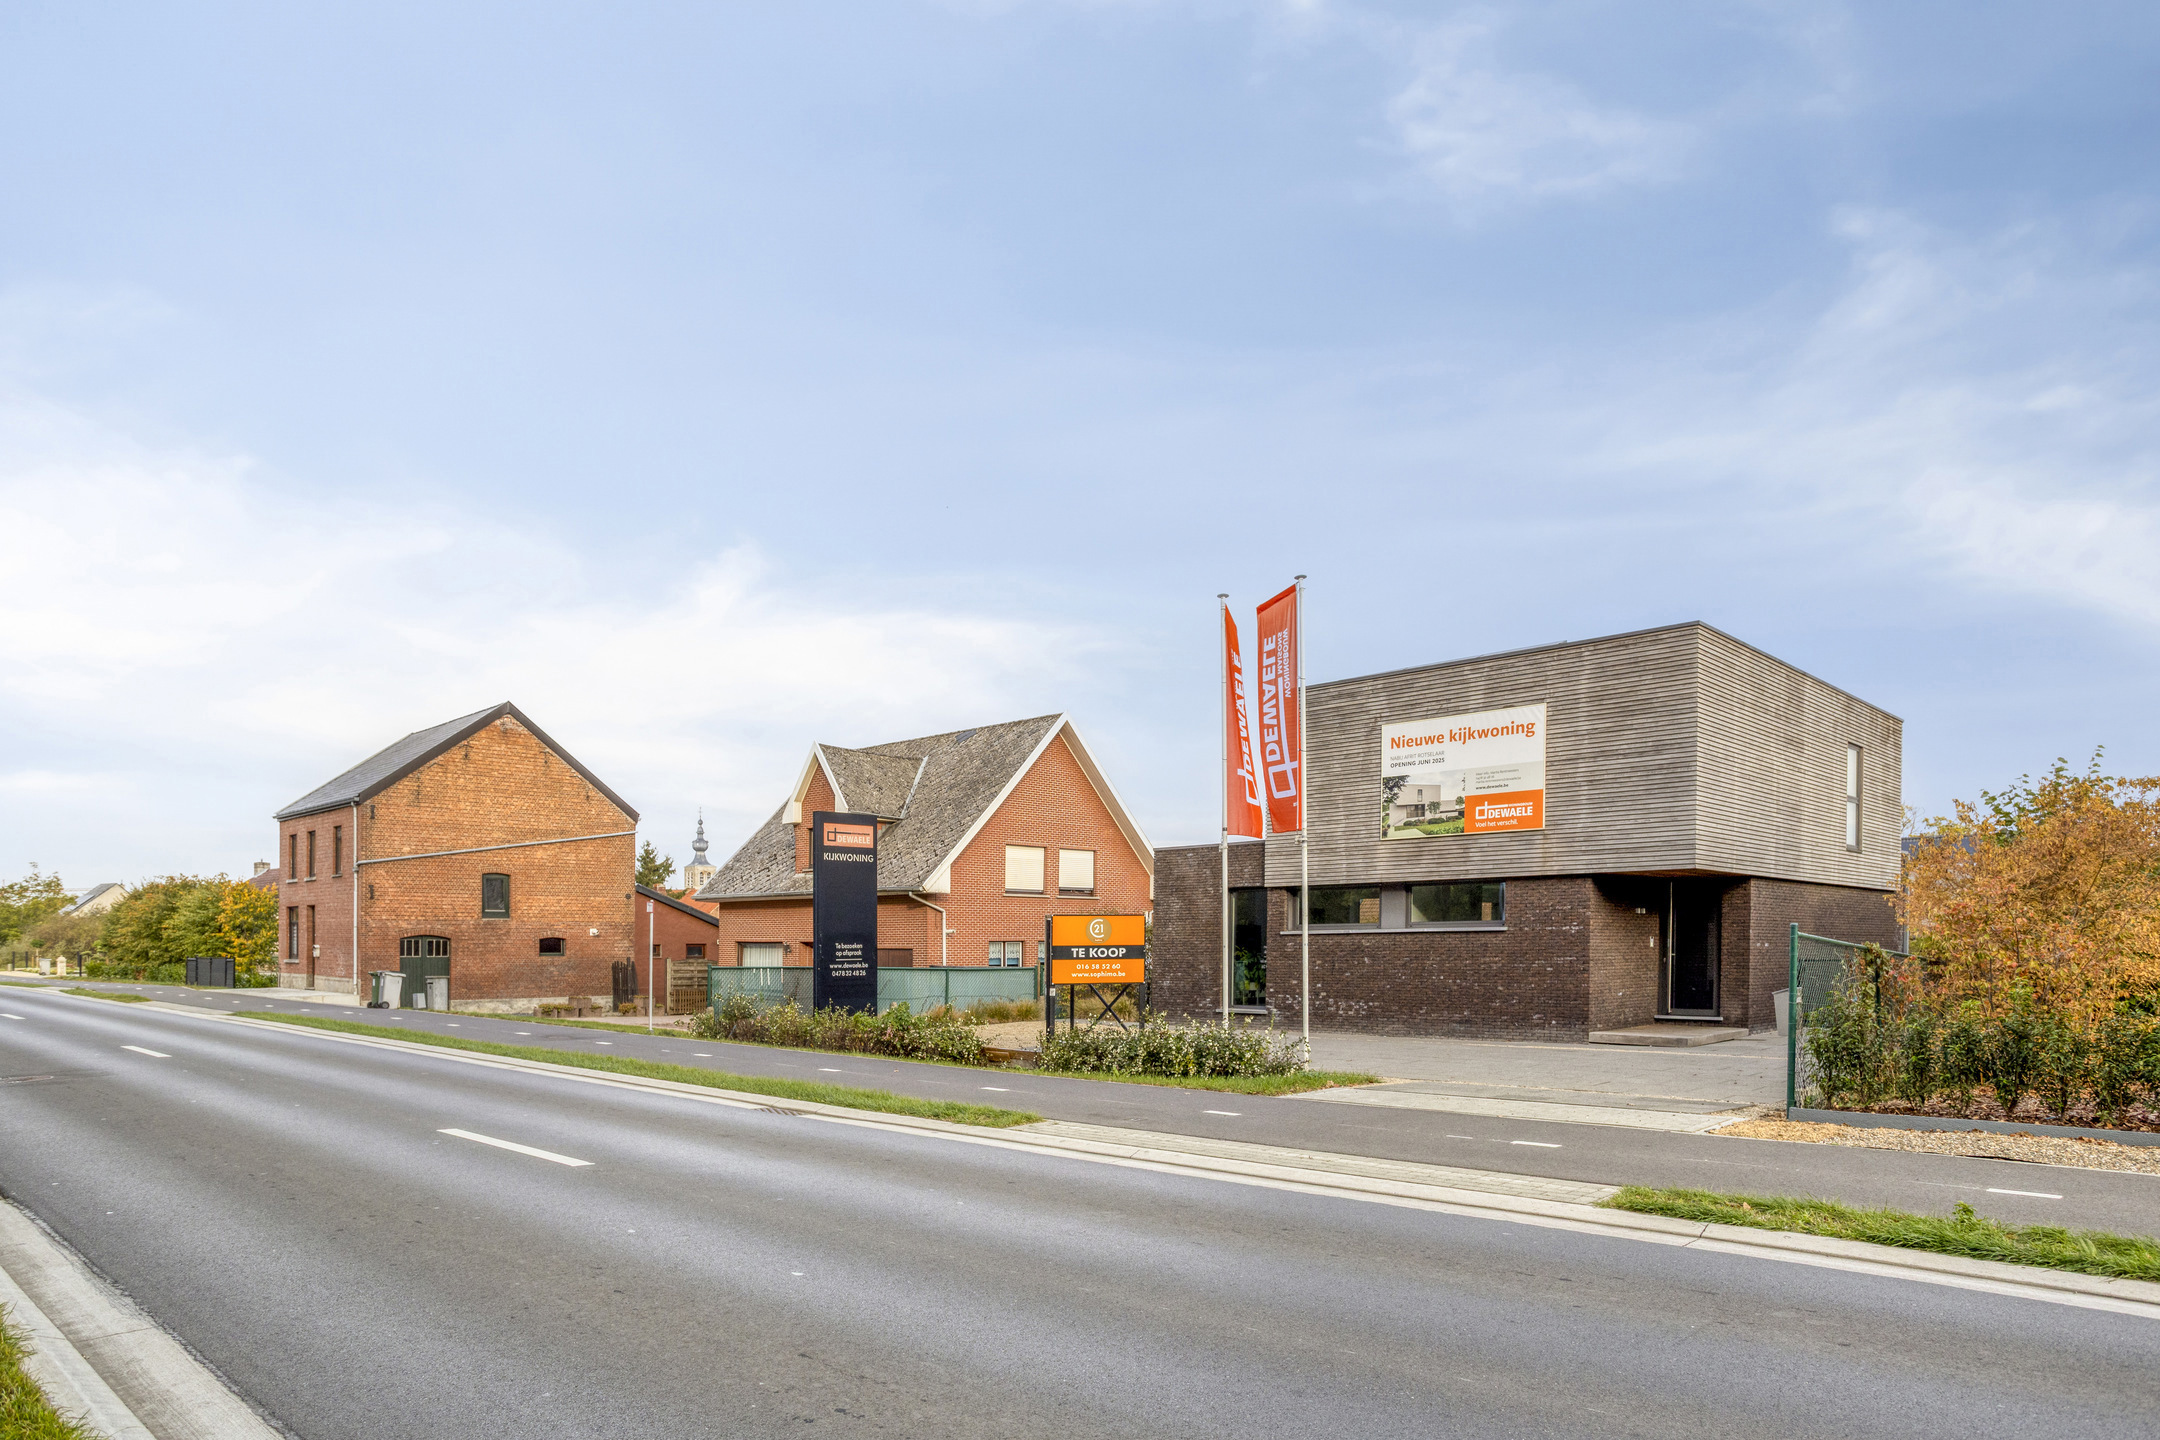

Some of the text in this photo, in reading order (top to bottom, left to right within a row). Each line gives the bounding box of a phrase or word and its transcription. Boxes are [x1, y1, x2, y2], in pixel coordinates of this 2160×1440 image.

[1390, 721, 1536, 750] Nieuwe kijkwoning
[1417, 751, 1444, 759] ROTSELAAR
[1390, 760, 1416, 768] OPENING
[1488, 806, 1533, 819] DEWAELE
[837, 835, 870, 845] DEWAELE
[823, 852, 874, 863] KIJKWONING
[1071, 947, 1126, 958] TE KOOP
